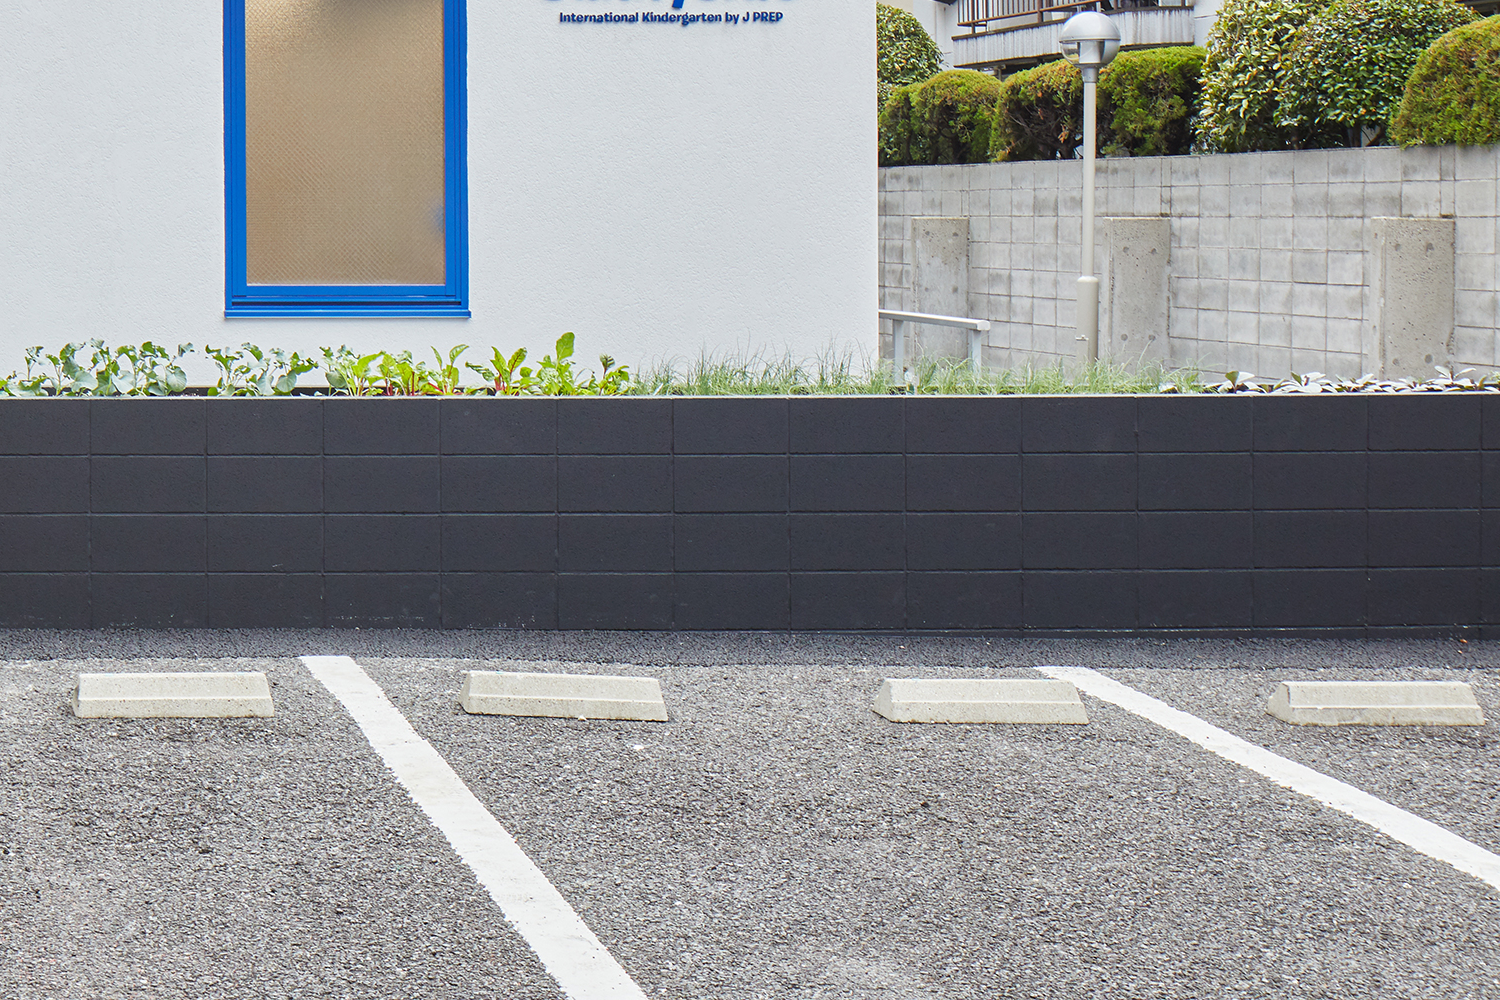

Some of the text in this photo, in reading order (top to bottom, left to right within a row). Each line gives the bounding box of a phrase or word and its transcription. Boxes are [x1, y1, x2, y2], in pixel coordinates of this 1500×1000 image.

[559, 11, 784, 26] International Kindergarten by J PREP
